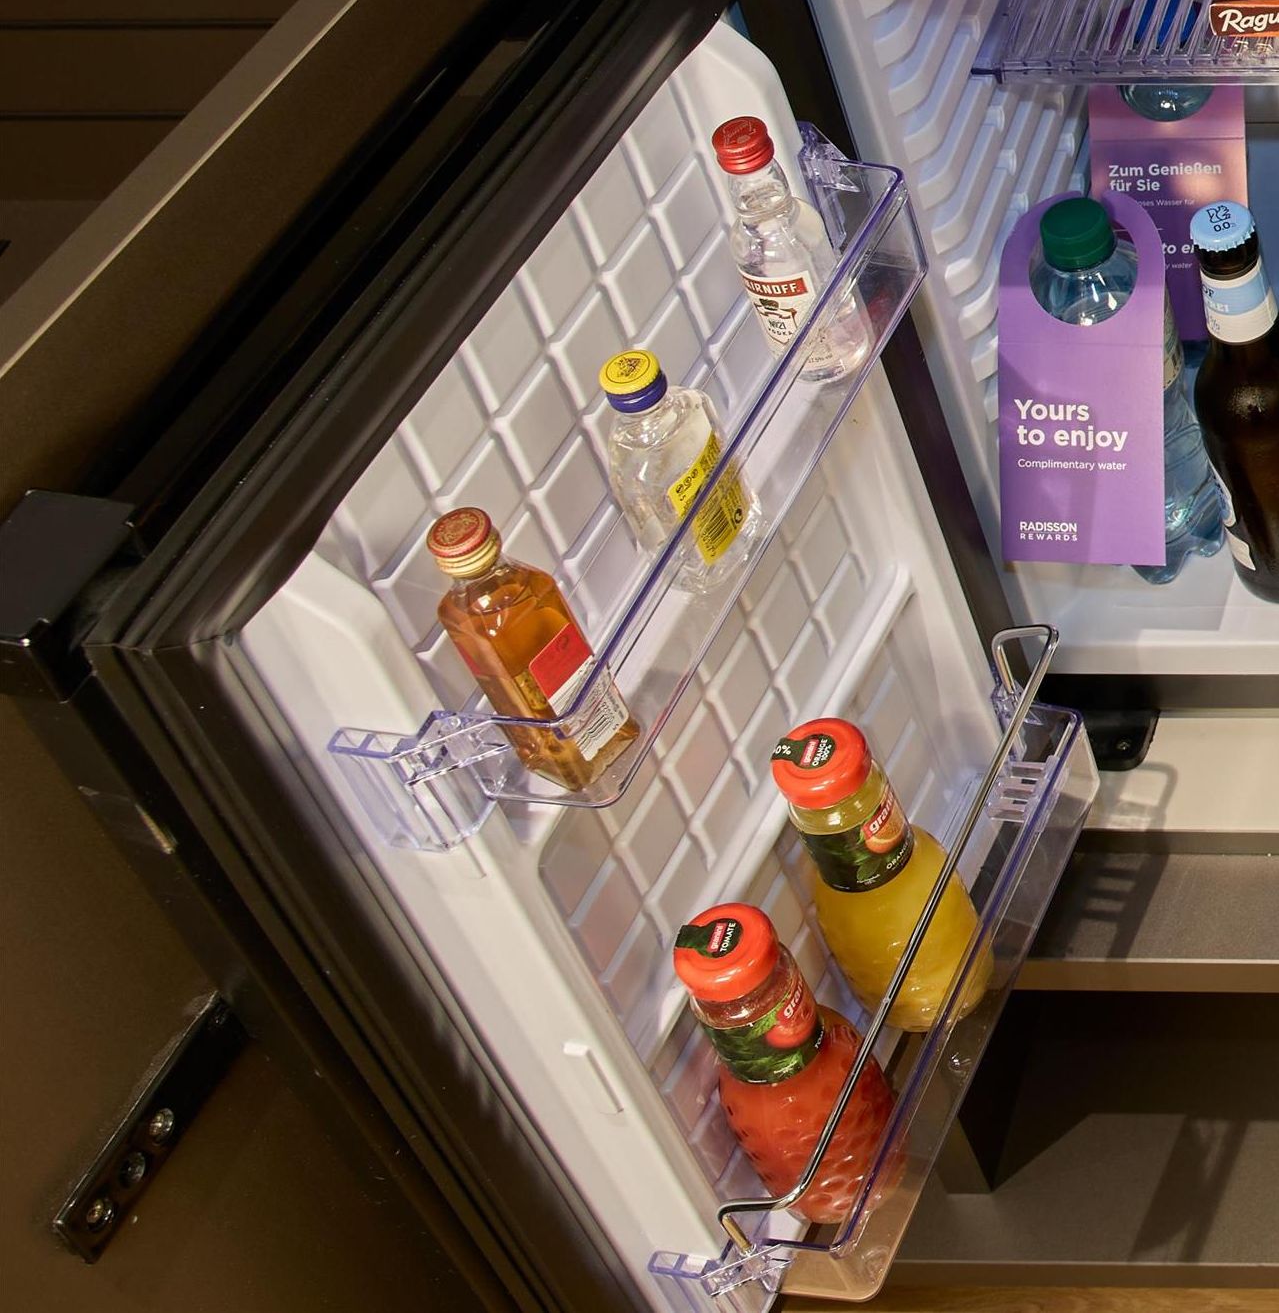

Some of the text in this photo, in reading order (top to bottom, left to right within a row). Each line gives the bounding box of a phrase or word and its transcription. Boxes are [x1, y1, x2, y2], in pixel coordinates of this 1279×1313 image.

[1108, 162, 1222, 177] Zum Genießen
[1110, 179, 1161, 192] für Sie
[1162, 243, 1177, 255] to
[1014, 398, 1090, 422] Yours
[1017, 425, 1128, 452] to enjoy
[1017, 459, 1127, 471] Complimentary water
[1019, 521, 1078, 533] RADISSON
[1020, 533, 1078, 542] REWARDS
[812, 738, 828, 766] ORANGE
[719, 922, 737, 952] TOMATE
